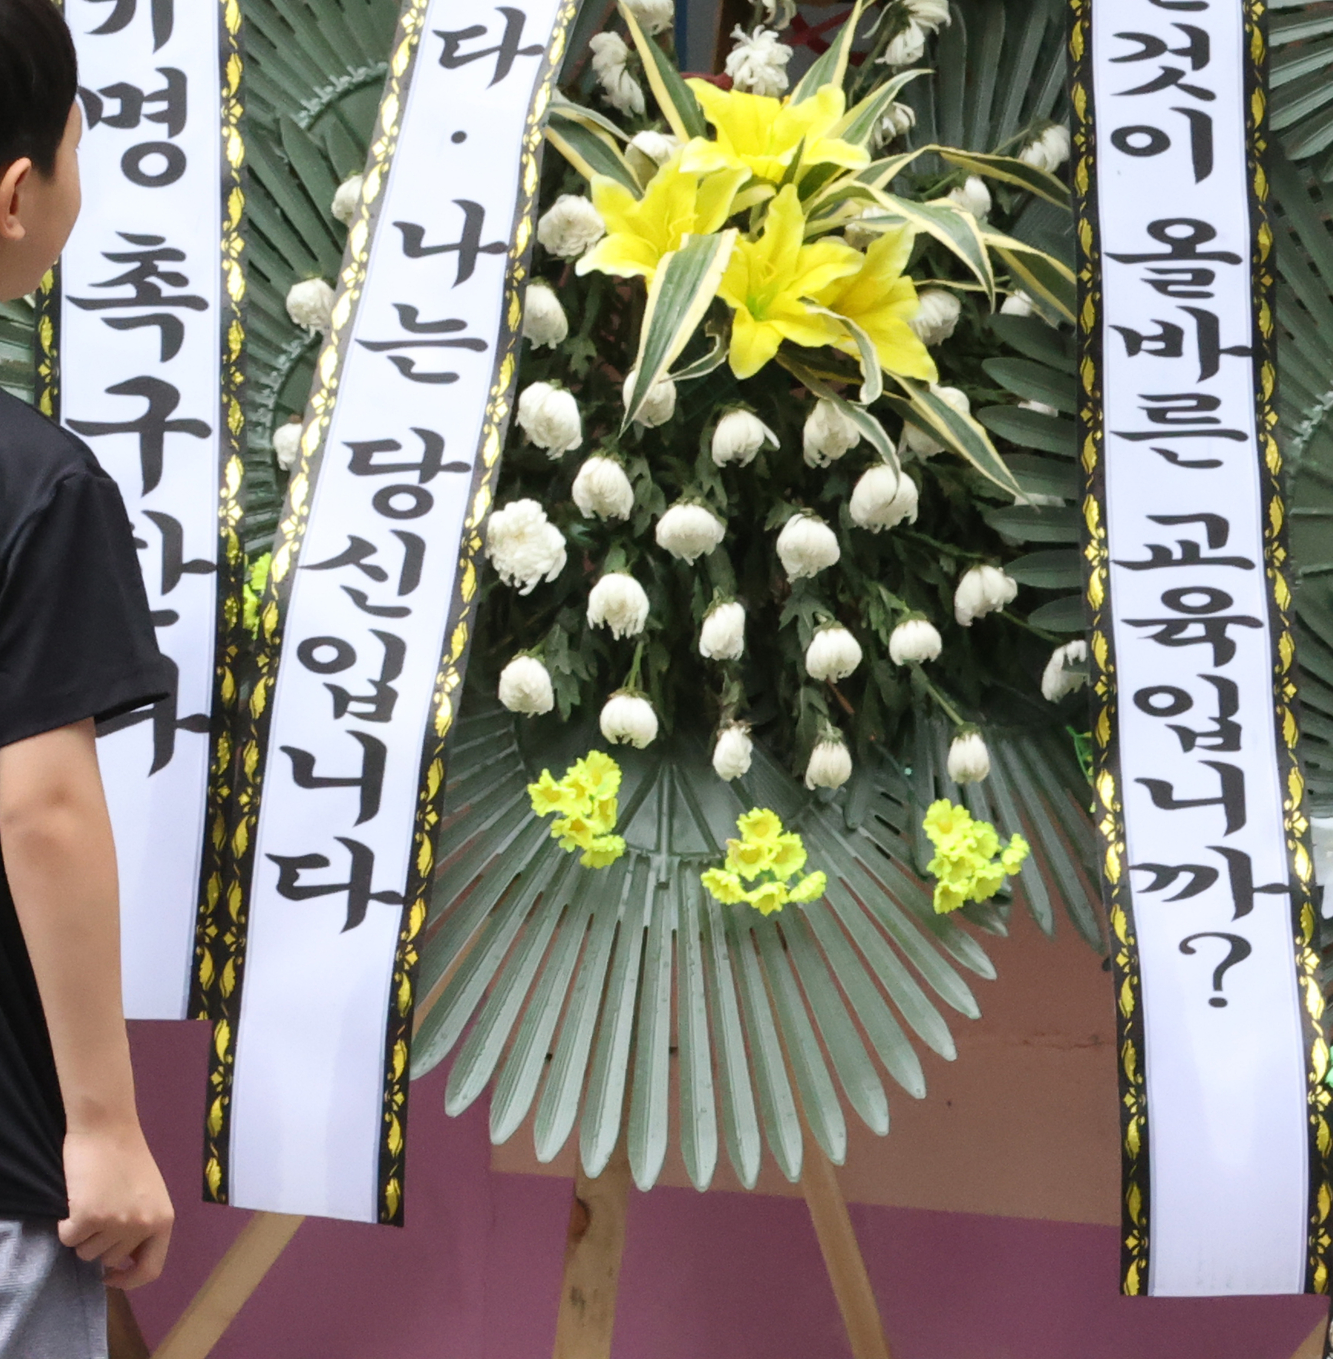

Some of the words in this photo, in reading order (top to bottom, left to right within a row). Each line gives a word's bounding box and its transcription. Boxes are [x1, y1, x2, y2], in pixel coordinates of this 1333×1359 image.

[355, 199, 509, 383] 나는
[1104, 217, 1253, 469] 올바른
[265, 427, 473, 934] 당신입니다
[1110, 512, 1290, 1010] 교육입니까?
